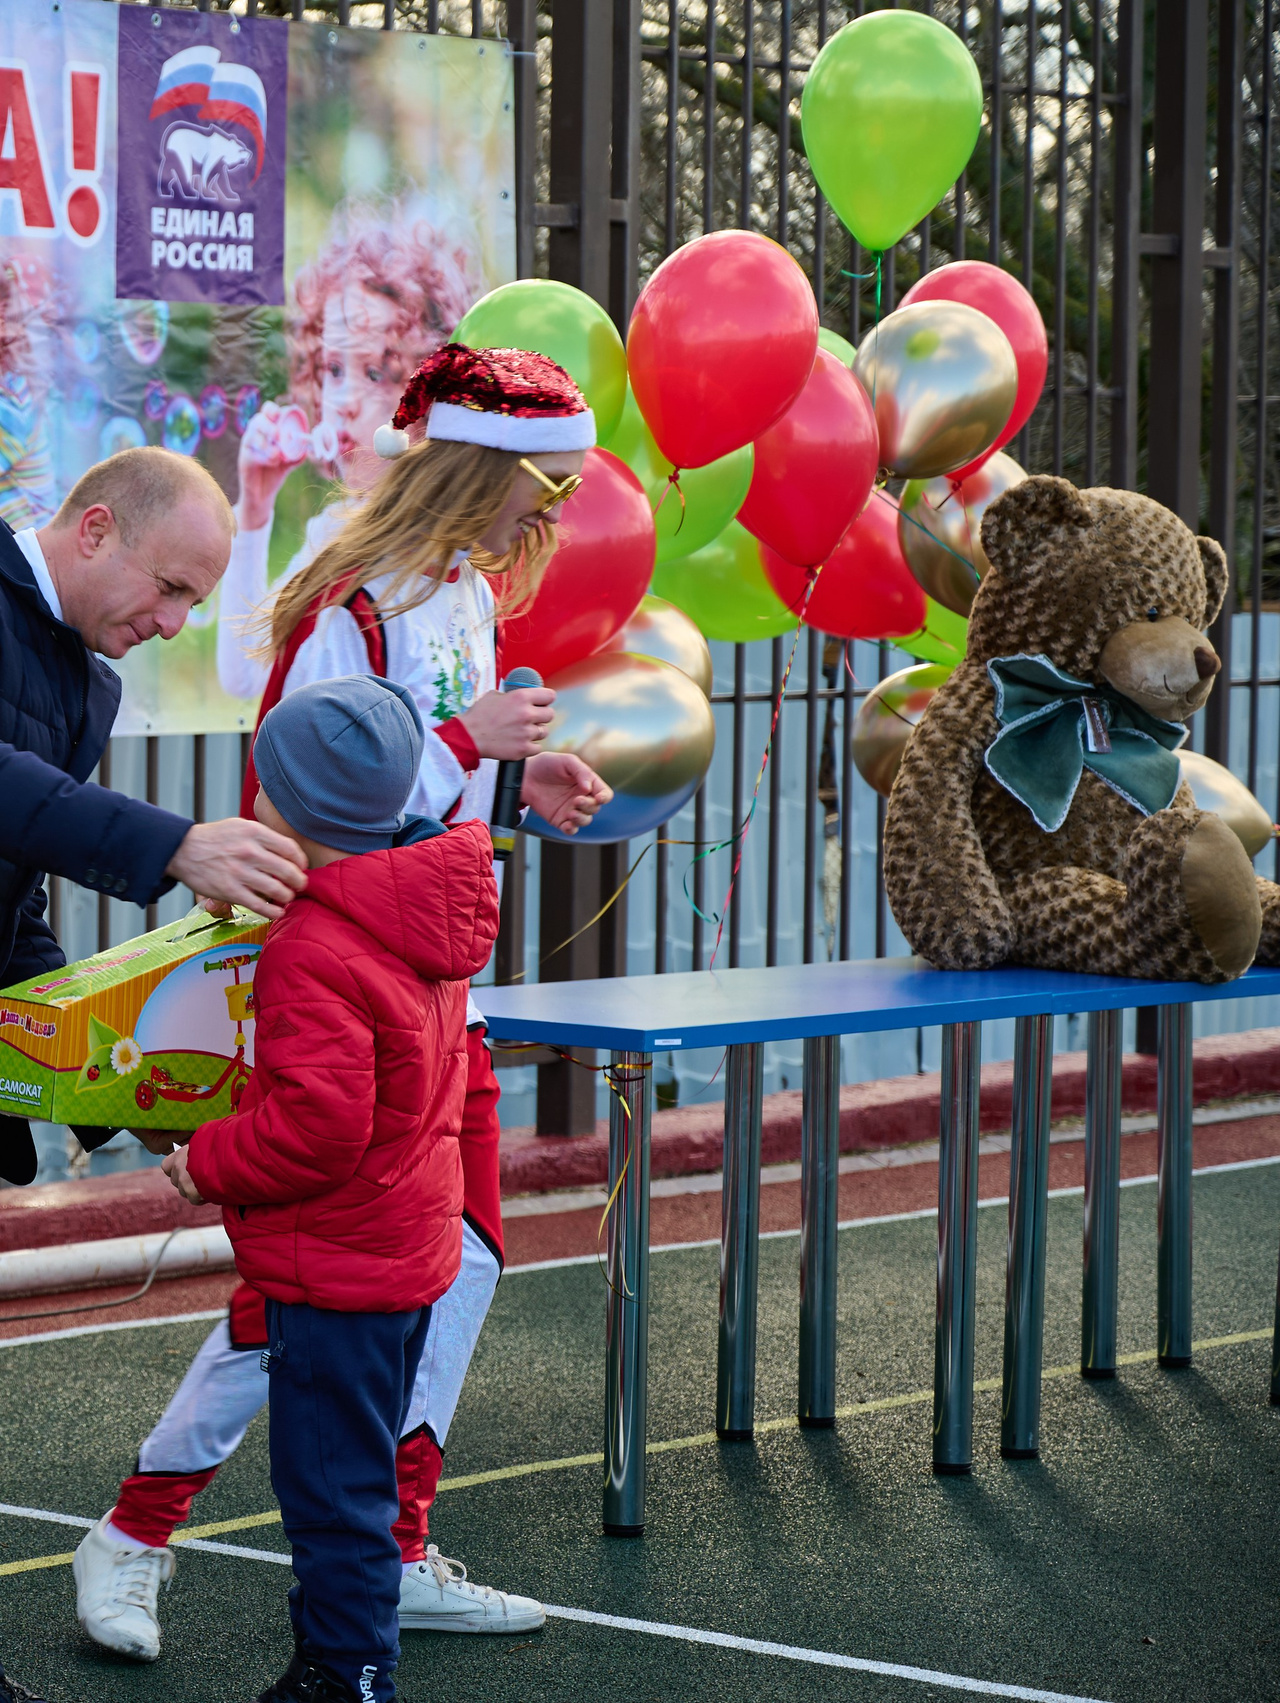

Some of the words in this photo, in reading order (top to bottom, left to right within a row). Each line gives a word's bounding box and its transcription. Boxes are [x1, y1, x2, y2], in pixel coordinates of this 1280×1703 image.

[151, 206, 255, 239] ЕДИНАЯ
[151, 239, 254, 271] РОССИЯ
[0, 1009, 20, 1027] Маша
